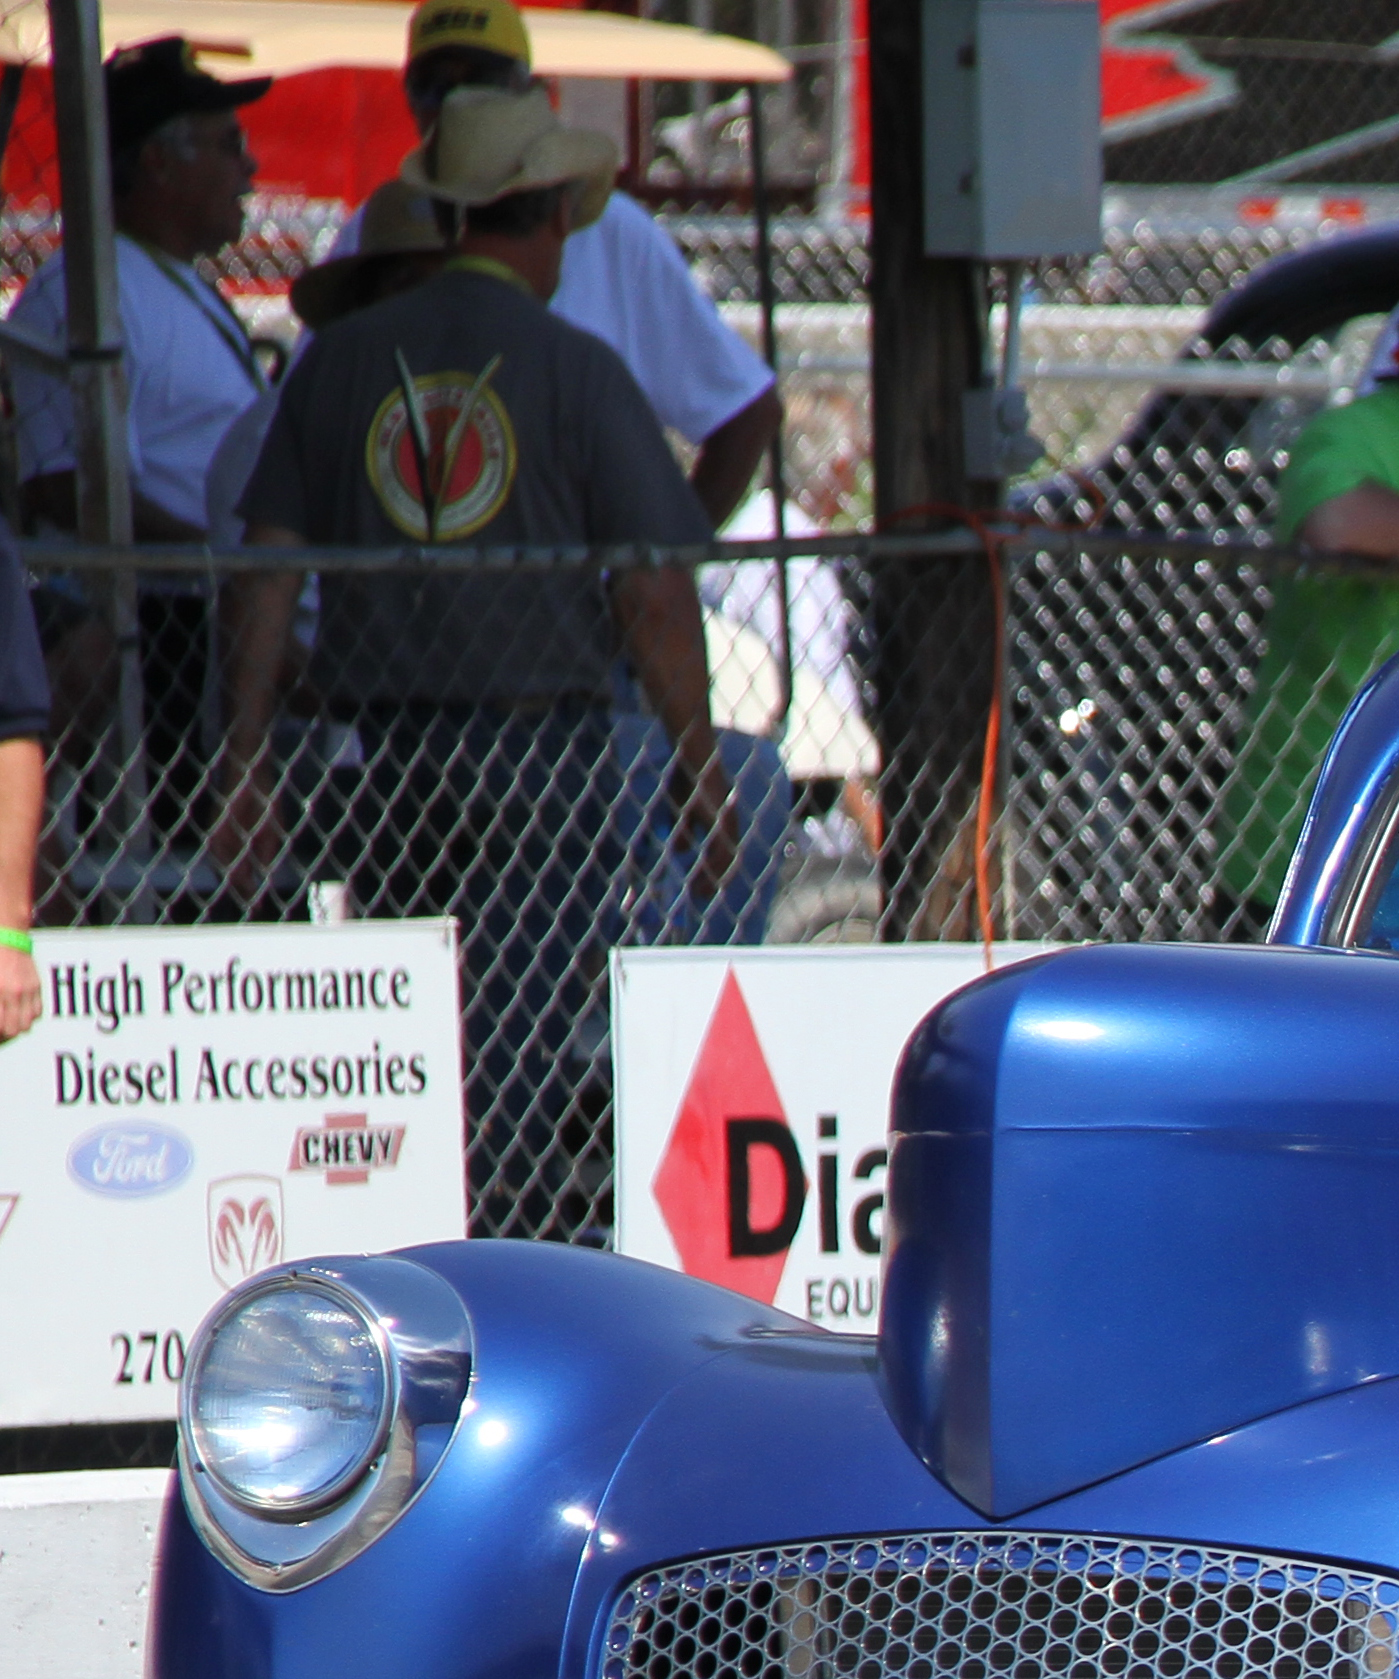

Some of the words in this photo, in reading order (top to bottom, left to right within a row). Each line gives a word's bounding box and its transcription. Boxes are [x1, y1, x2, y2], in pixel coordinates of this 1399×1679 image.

[50, 960, 145, 1034] High
[162, 957, 411, 1016] Performance
[53, 1044, 181, 1105] Diesel
[195, 1040, 427, 1102] Accessories
[93, 1130, 167, 1184] Ford
[302, 1130, 395, 1167] CHEVY
[110, 1330, 185, 1385] 270
